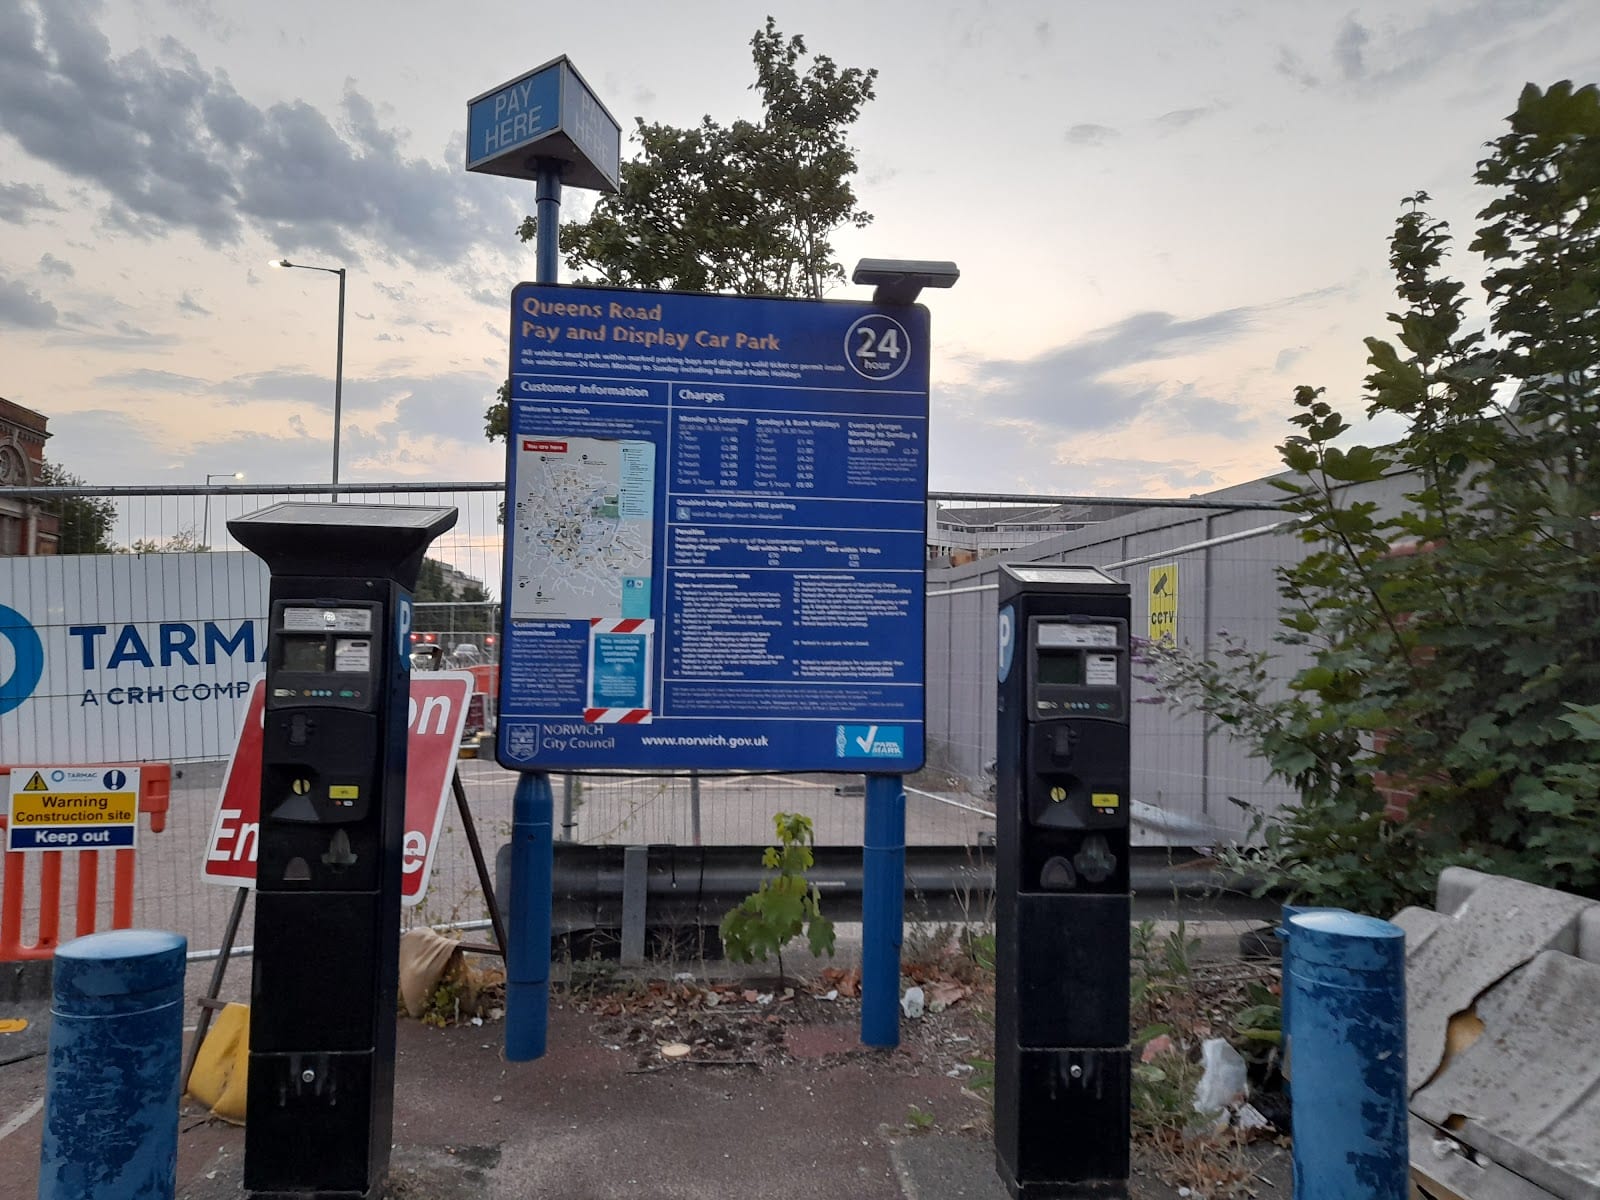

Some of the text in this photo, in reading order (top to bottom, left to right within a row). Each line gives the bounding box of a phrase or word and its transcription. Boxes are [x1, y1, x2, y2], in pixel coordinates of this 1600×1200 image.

[494, 80, 533, 120] PAY
[485, 106, 542, 154] HERE
[522, 297, 662, 320] Queens Road
[522, 321, 780, 350] Pay and Display Car Park
[856, 327, 901, 359] 24
[864, 359, 891, 370] hour
[520, 381, 649, 397] Customer Information
[678, 389, 725, 403] Charges
[1151, 610, 1173, 624] CCTV
[80, 689, 99, 706] A
[107, 685, 164, 705] CRH
[543, 724, 604, 735] NORWICH
[543, 737, 615, 751] City Council
[641, 735, 768, 748] www.norwich.gov.uk
[42, 796, 108, 809] Warning
[16, 810, 131, 822] Construction site
[35, 830, 110, 845] Keep out
